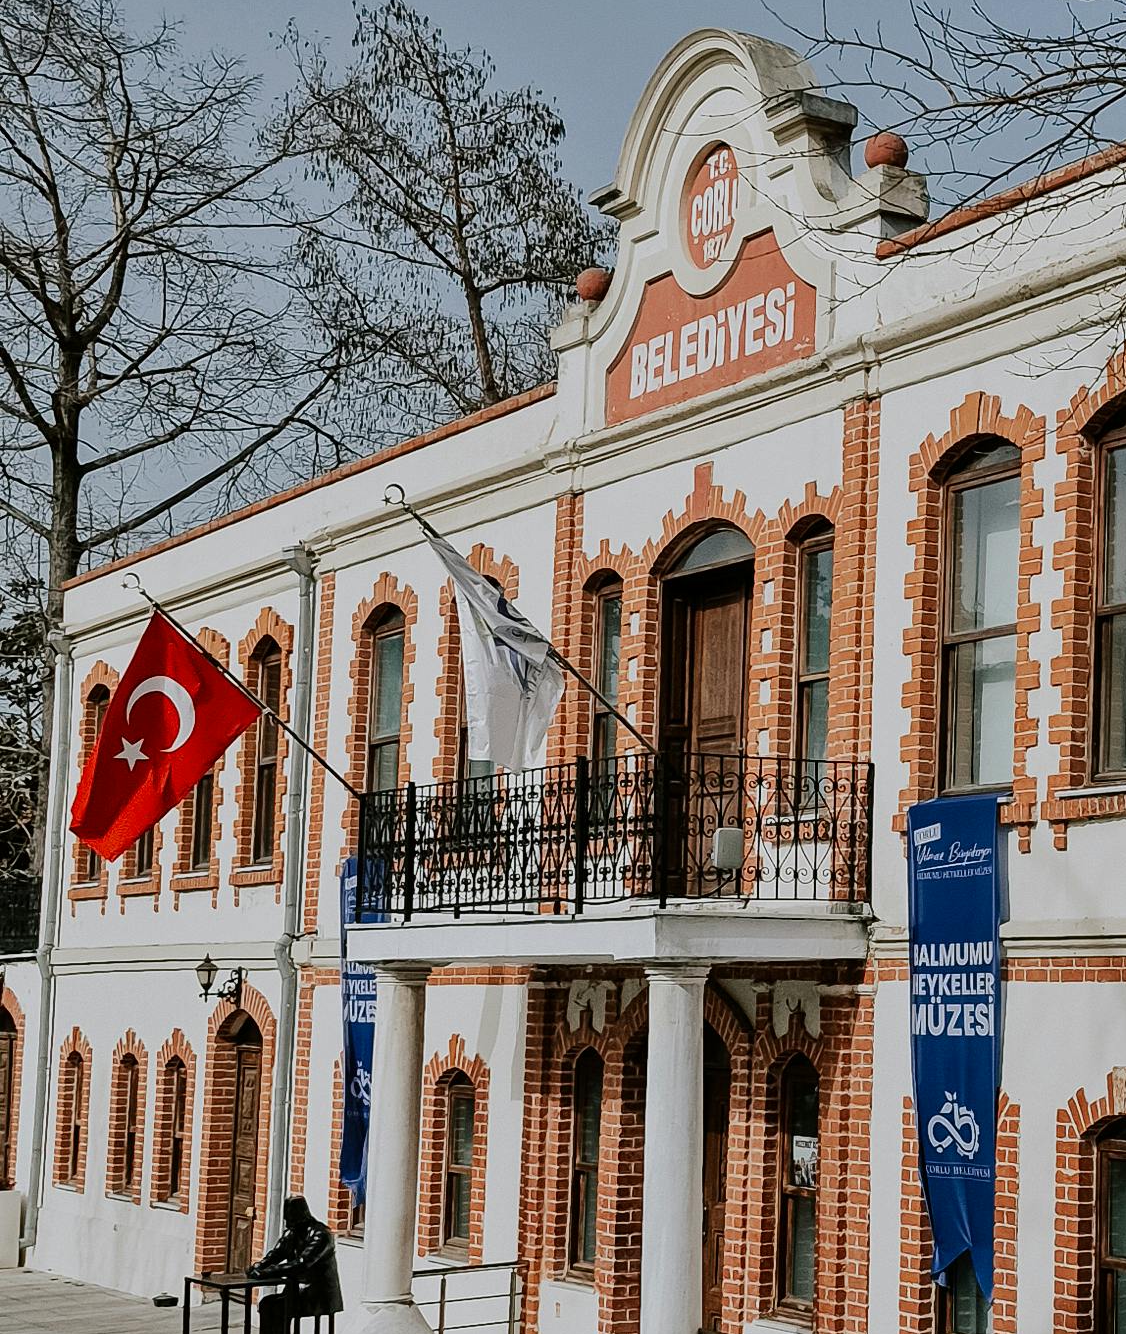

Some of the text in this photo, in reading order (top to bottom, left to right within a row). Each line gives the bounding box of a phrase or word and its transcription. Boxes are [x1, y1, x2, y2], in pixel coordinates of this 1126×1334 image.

[706, 149, 732, 180] T.C.
[629, 281, 796, 400] BELEDİYESİ
[913, 940, 994, 967] BALMUMU
[911, 995, 995, 1037] MÜZESİ
